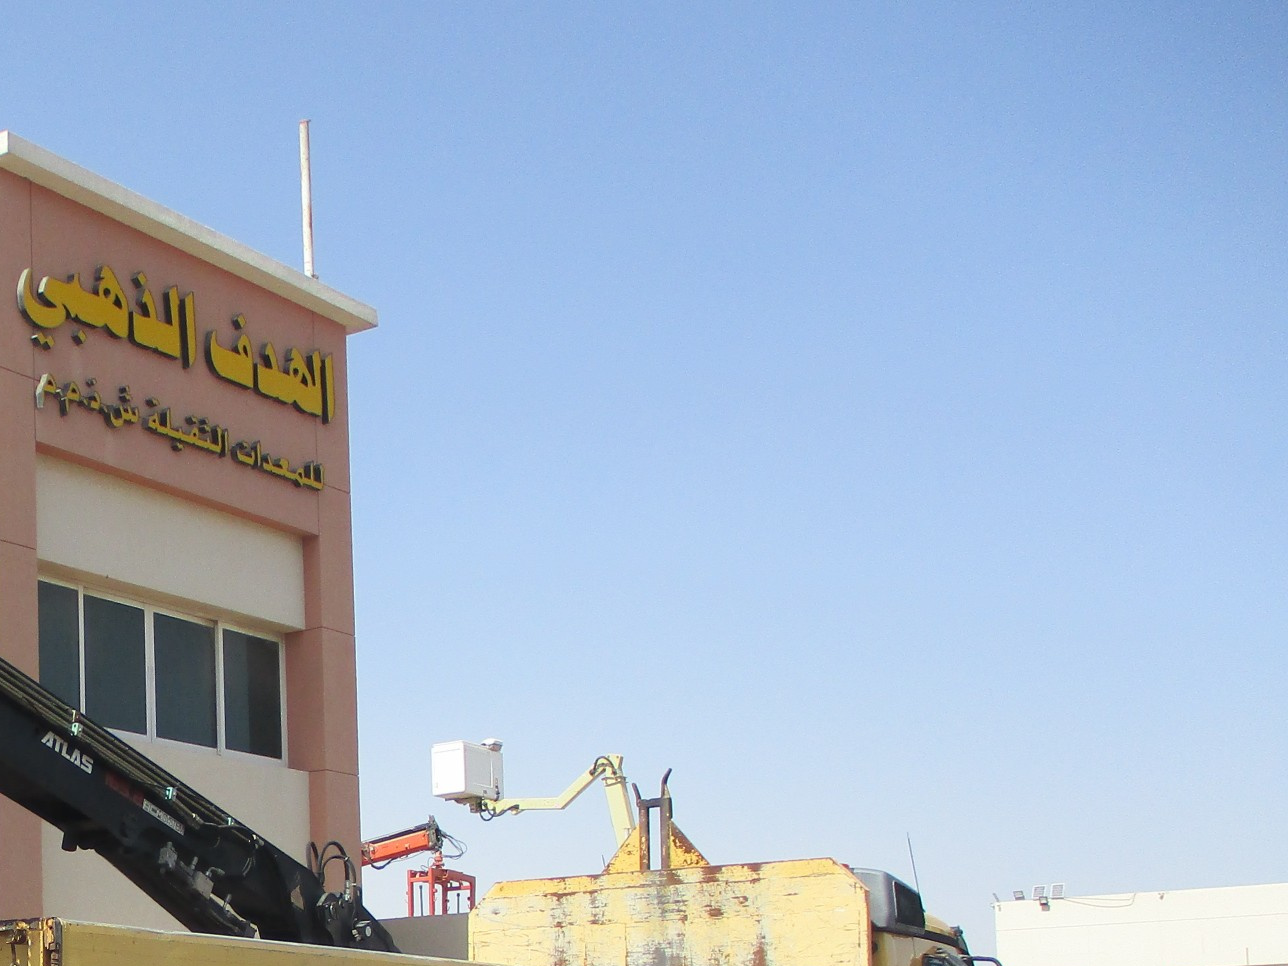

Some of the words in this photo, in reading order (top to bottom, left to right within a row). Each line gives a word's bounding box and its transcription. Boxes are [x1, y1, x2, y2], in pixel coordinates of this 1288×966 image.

[16, 264, 197, 369] الذهبي
[205, 313, 335, 424] الهدف
[142, 397, 229, 458] الثقيلة
[231, 440, 325, 490] للمعدات
[40, 731, 94, 775] ATLAS
